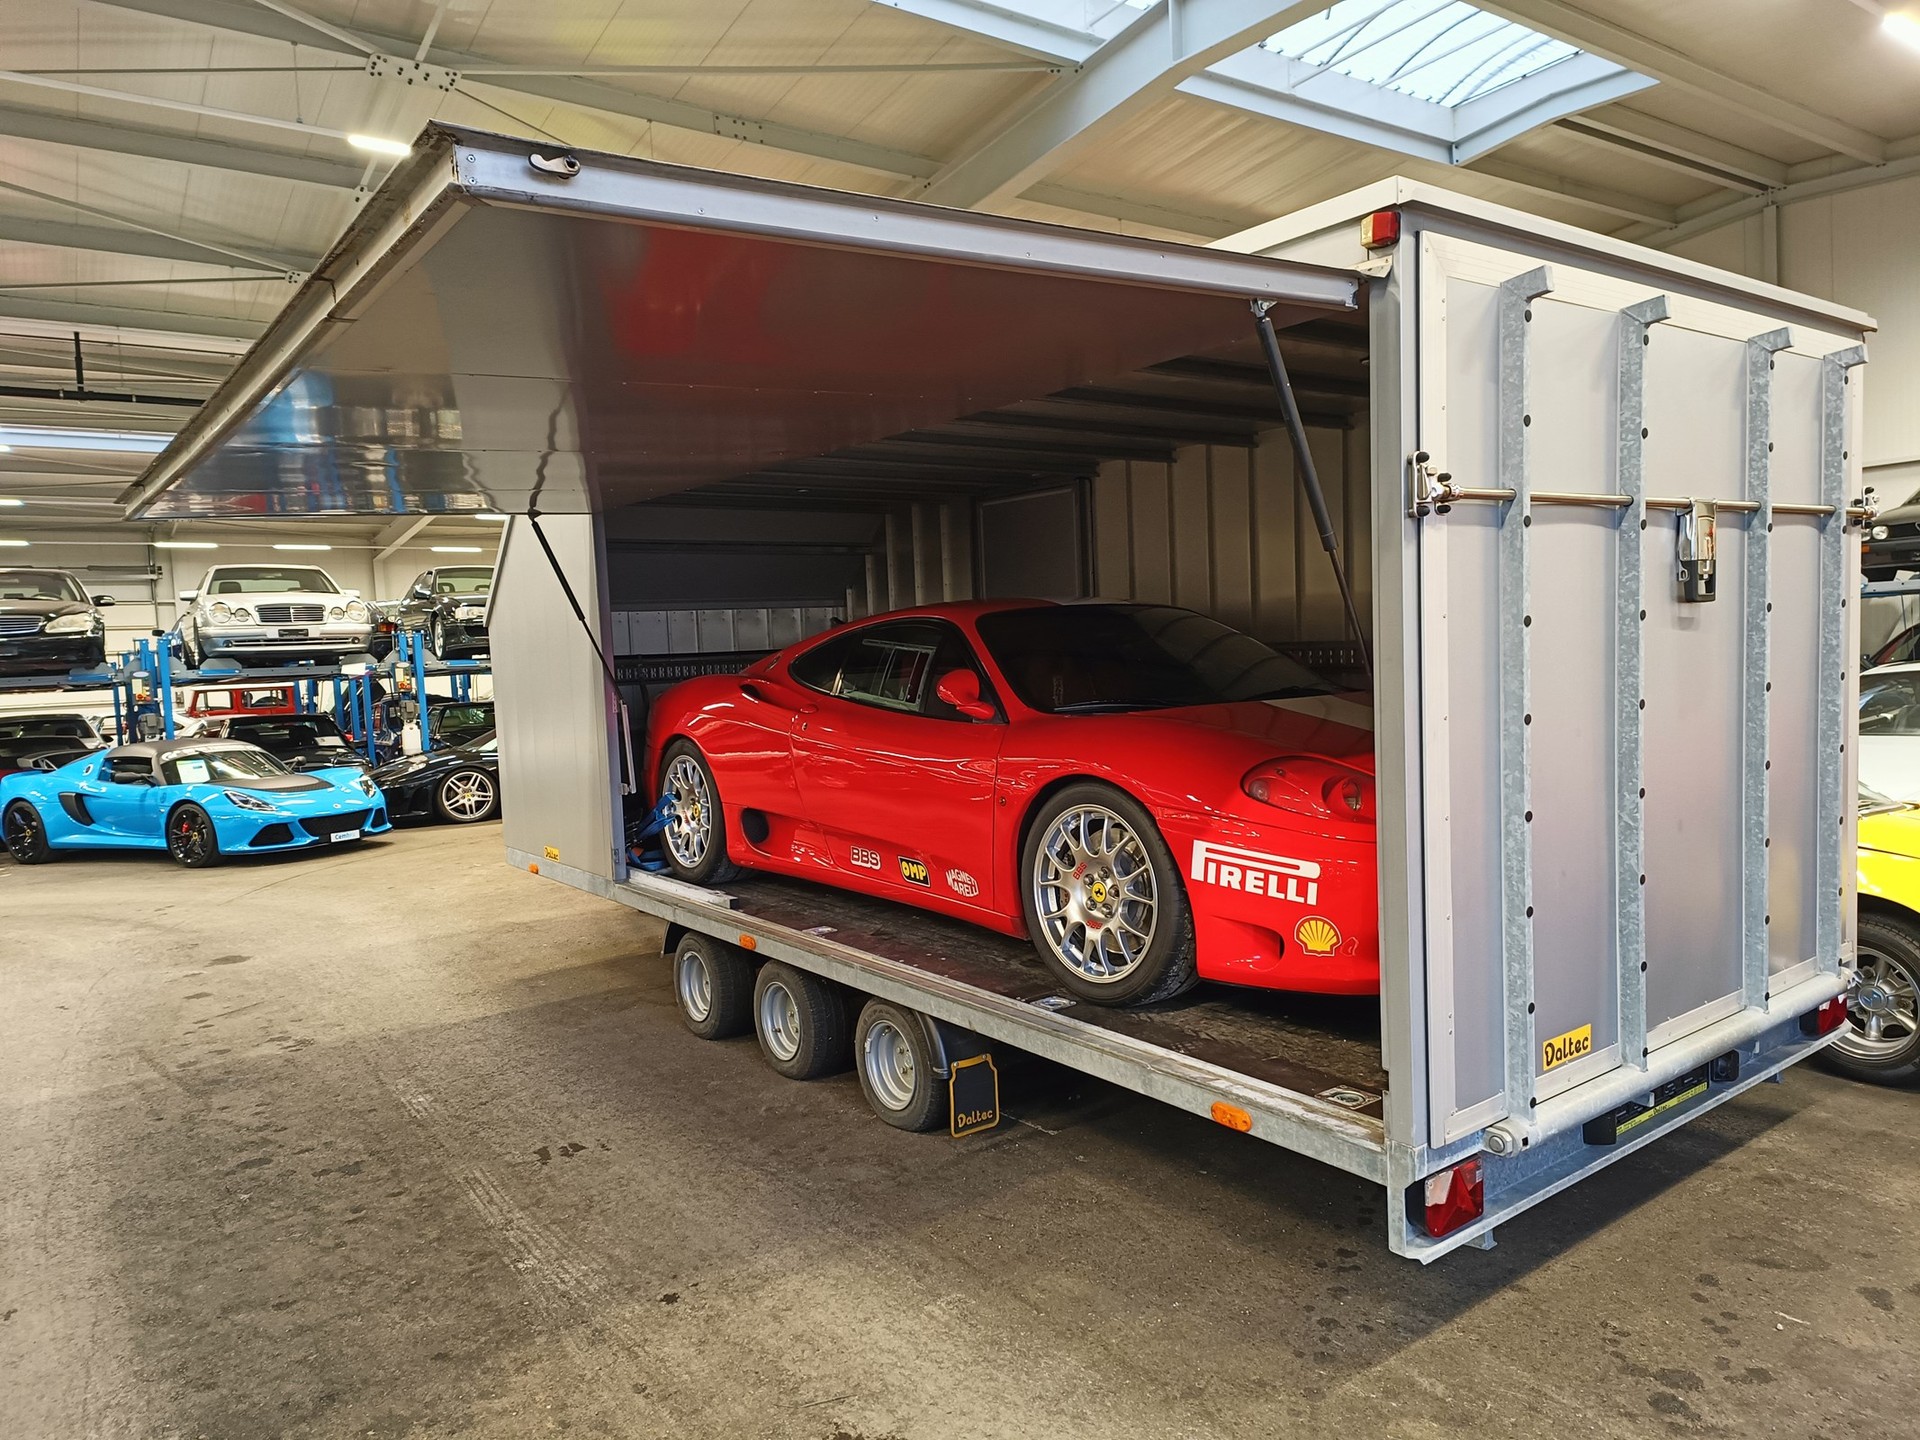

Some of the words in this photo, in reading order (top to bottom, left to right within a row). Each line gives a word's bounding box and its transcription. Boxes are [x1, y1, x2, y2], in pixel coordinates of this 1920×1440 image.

[851, 846, 881, 870] BBS
[901, 861, 926, 881] OMP
[1190, 839, 1321, 906] PIRELLI
[1544, 1036, 1589, 1067] Daltec
[957, 1110, 993, 1128] Daltec
